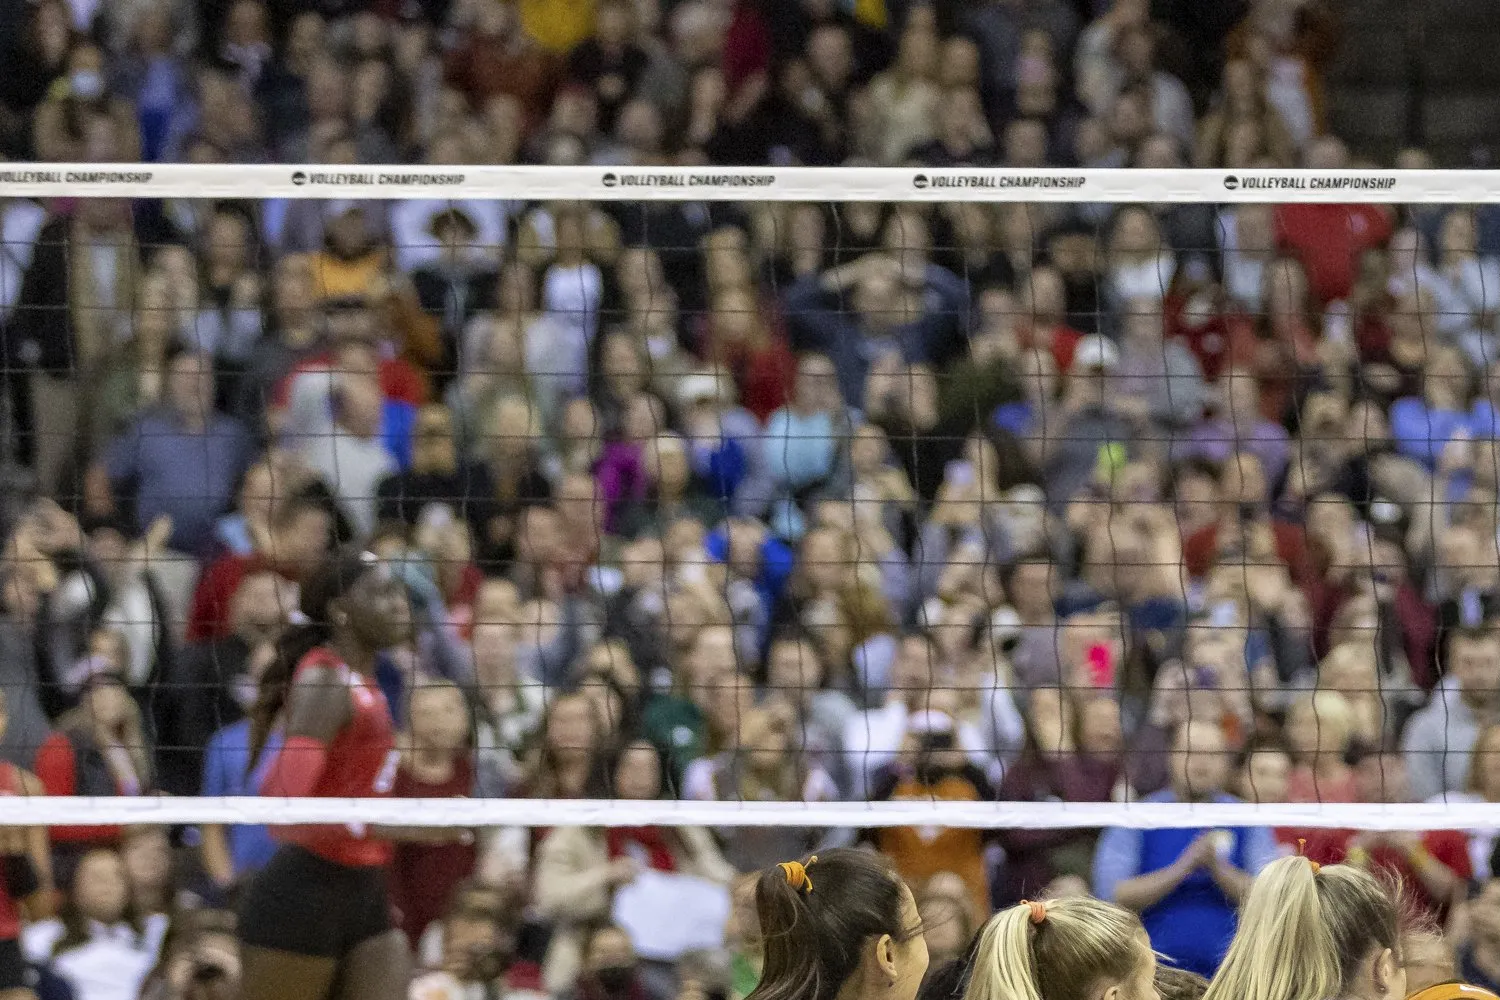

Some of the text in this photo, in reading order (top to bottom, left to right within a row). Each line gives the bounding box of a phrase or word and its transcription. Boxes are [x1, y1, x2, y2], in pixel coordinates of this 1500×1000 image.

[65, 171, 153, 183] CHAMPIONSHIP
[310, 173, 374, 185] VOLLEYBALL
[378, 173, 465, 185] CHAMPIONSHIP
[620, 174, 685, 186] VOLLEYBALL
[688, 174, 775, 186] CHAMPIONSHIP
[931, 175, 996, 187] VOLLEYBALL
[999, 175, 1086, 187] CHAMPIONSHIP
[1242, 176, 1306, 188] VOLLEYBALL
[1309, 176, 1396, 188] CHAMPIONSHIP
